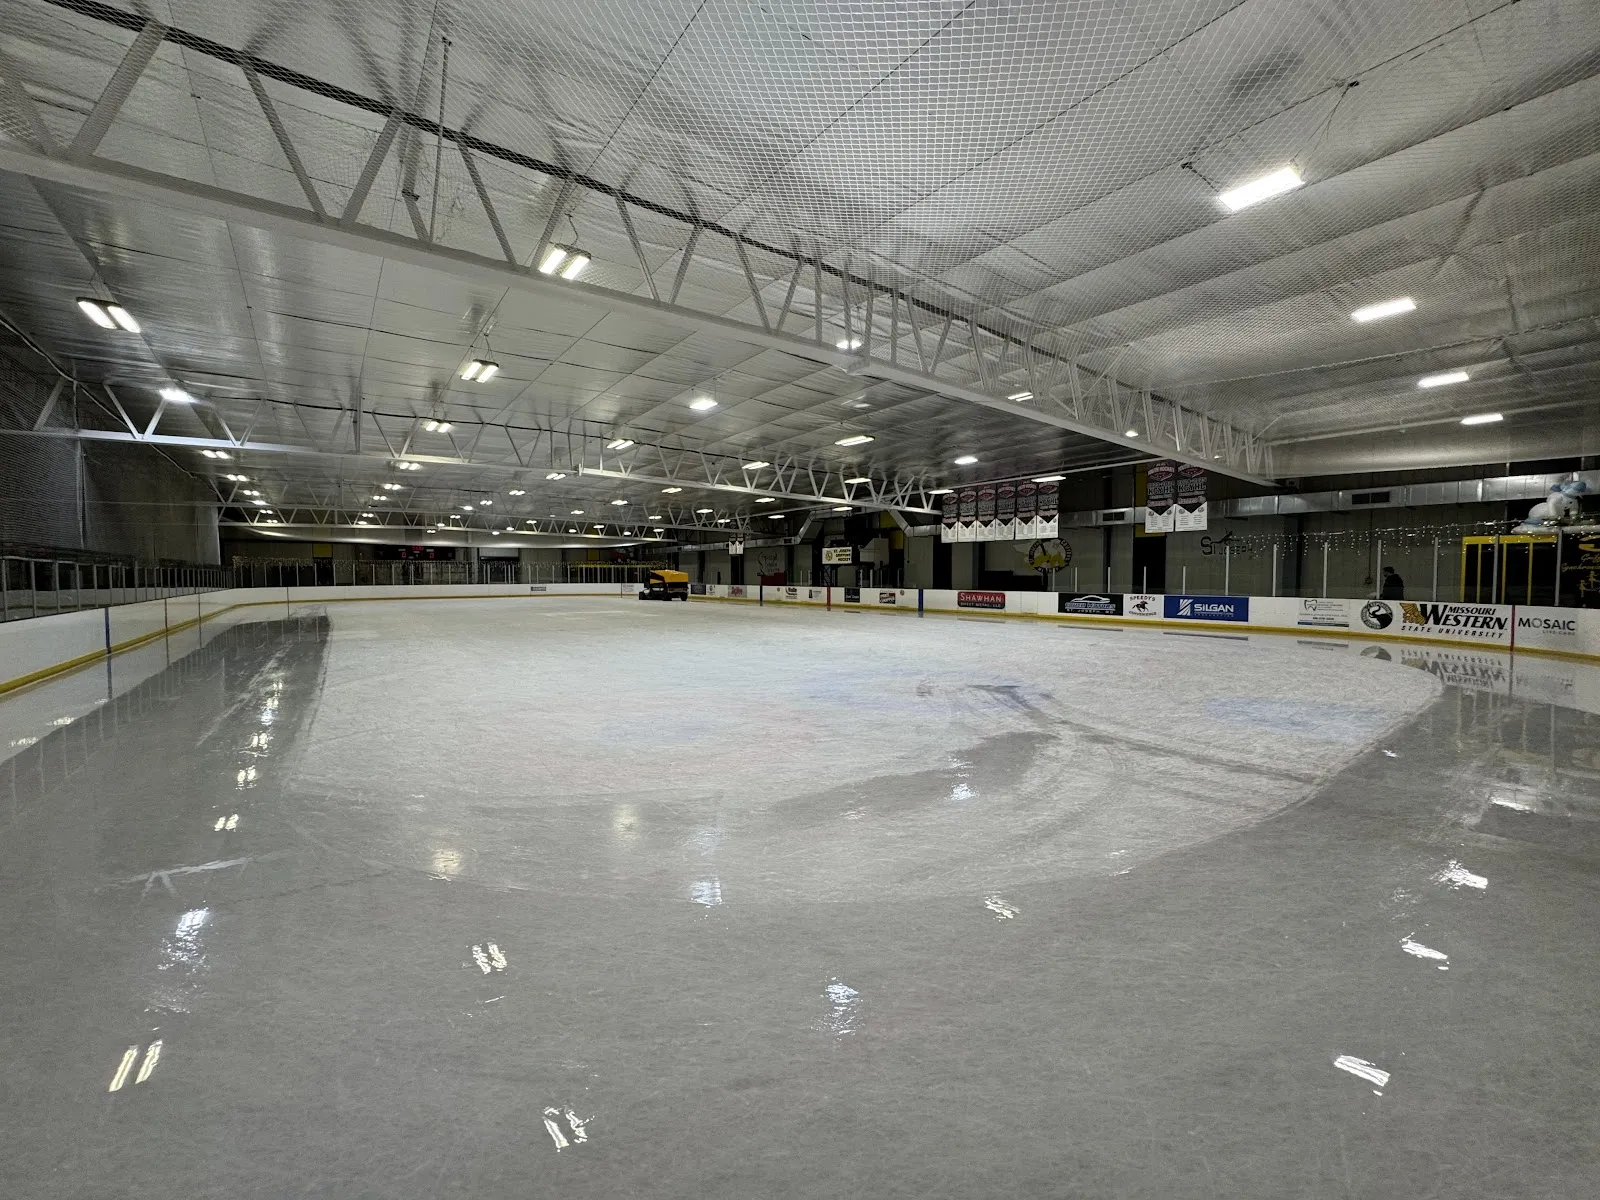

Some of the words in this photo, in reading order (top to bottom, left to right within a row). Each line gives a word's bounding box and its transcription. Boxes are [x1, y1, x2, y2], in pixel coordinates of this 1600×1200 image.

[960, 592, 1002, 602] SHAWHAN
[1194, 603, 1234, 612] SILGAN
[1448, 606, 1496, 616] MISSOURI
[1420, 604, 1508, 630] WESTERN
[1518, 617, 1576, 631] MOSAIC
[1401, 625, 1432, 633] STATE
[1438, 628, 1504, 639] UNIVERSITY
